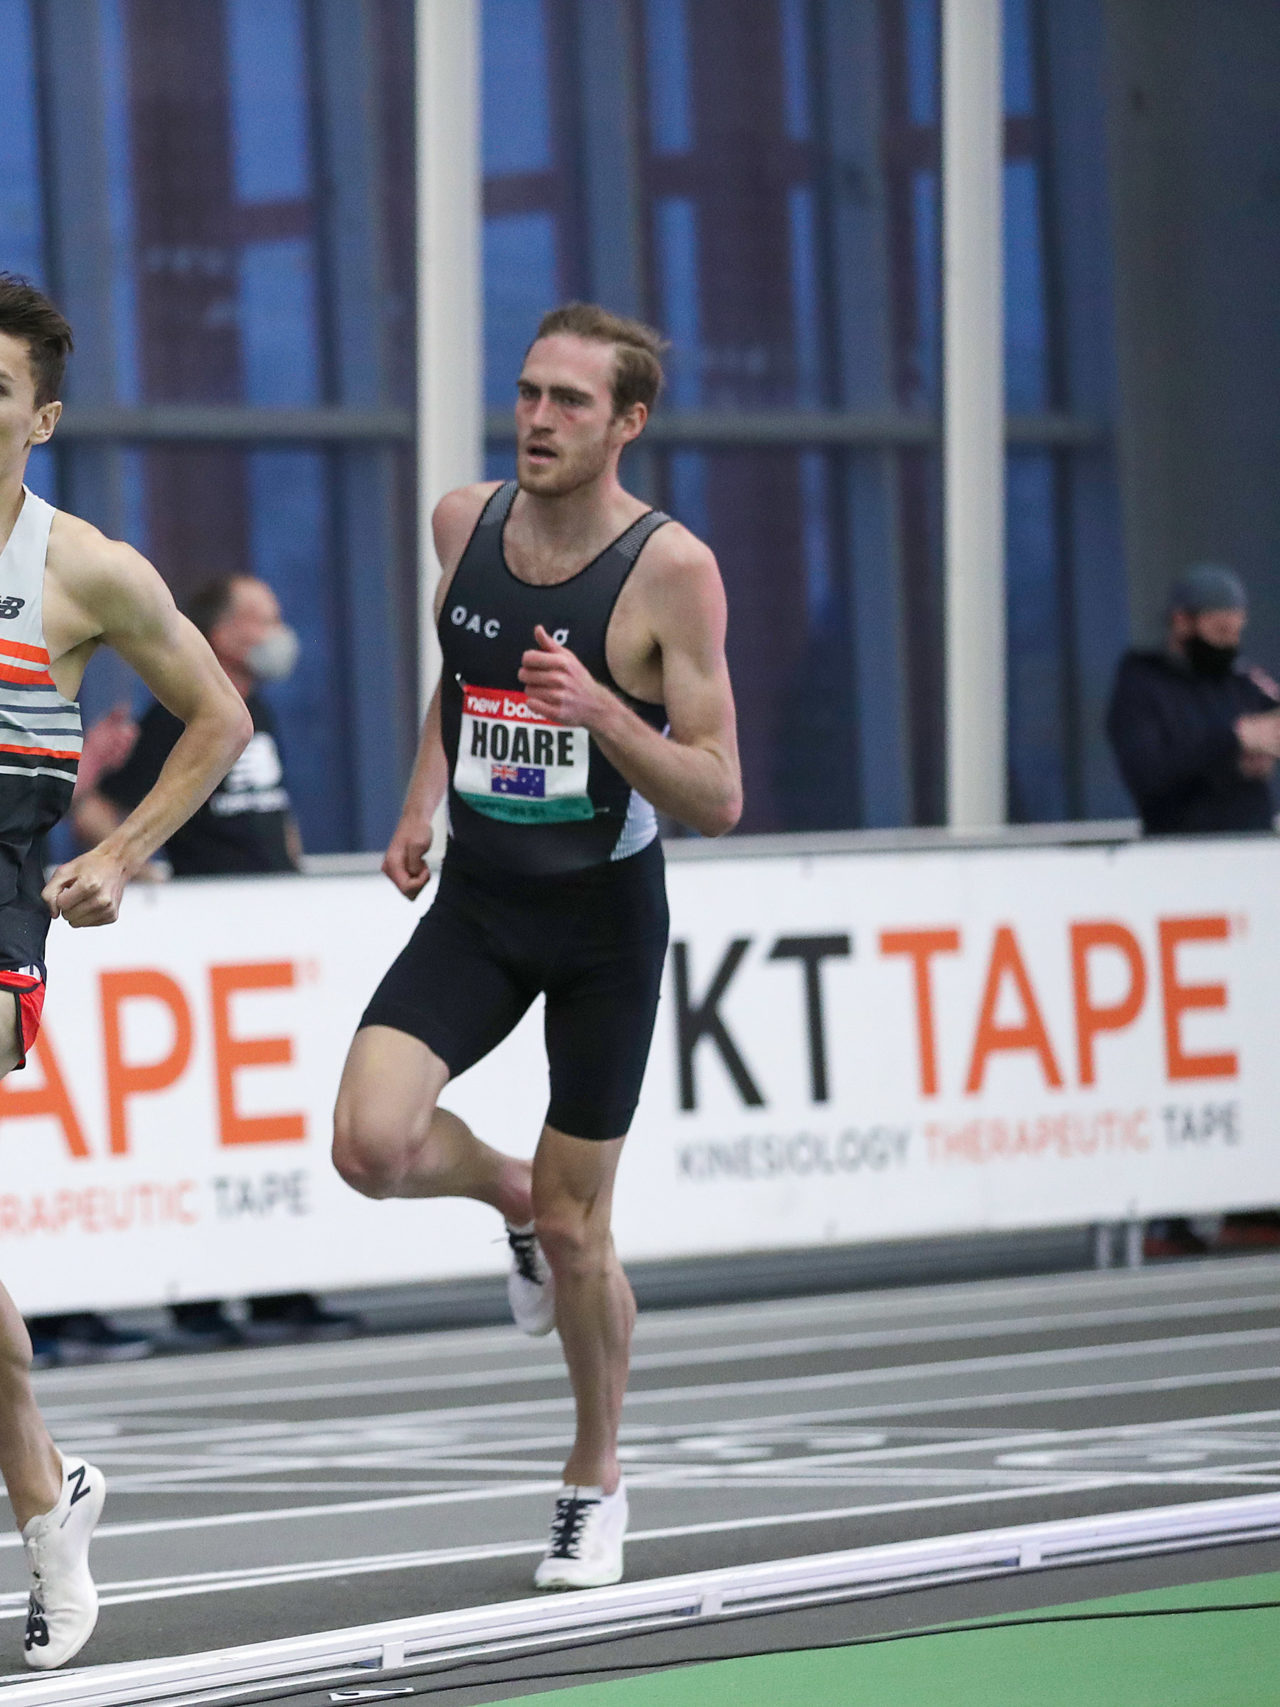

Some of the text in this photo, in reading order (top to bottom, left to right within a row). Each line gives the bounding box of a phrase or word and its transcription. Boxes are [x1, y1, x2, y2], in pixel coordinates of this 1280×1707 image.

[450, 605, 501, 639] OAC
[466, 695, 500, 715] new
[470, 719, 575, 767] HOARE
[672, 913, 1239, 1114] KT TAPE
[677, 1102, 1240, 1182] KINESIOLOGY THERAPEUTIC TAPE
[213, 1169, 313, 1219] TAPE
